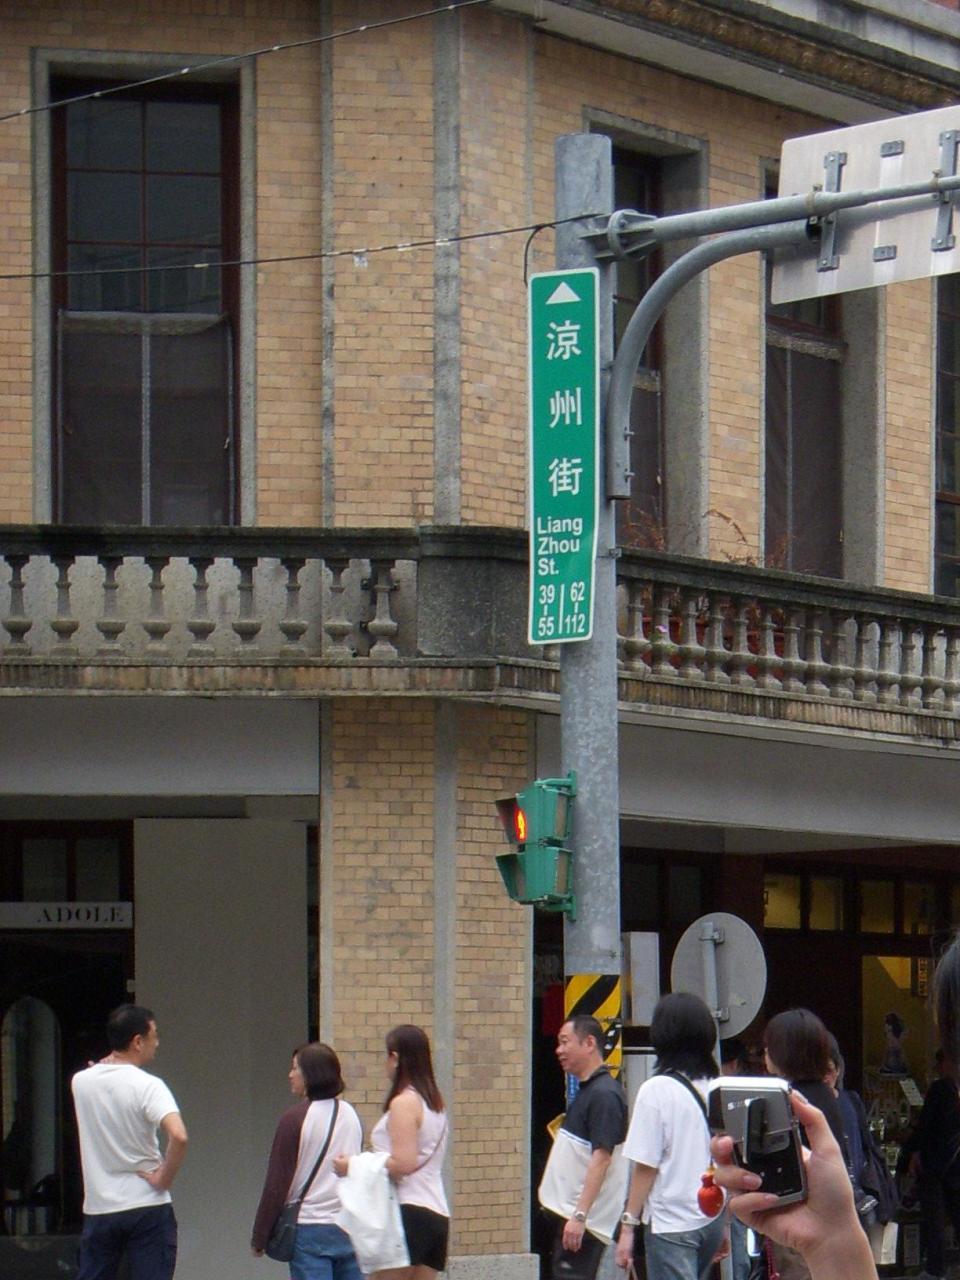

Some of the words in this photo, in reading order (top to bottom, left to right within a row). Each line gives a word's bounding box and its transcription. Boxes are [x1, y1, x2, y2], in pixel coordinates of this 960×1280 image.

[546, 320, 583, 497] 涼州街
[537, 516, 583, 536] Liang
[537, 537, 580, 555] Zhou
[538, 557, 559, 576] St.
[539, 584, 555, 605] 39
[570, 581, 585, 602] 62
[538, 616, 555, 636] 55
[565, 613, 586, 634] 112
